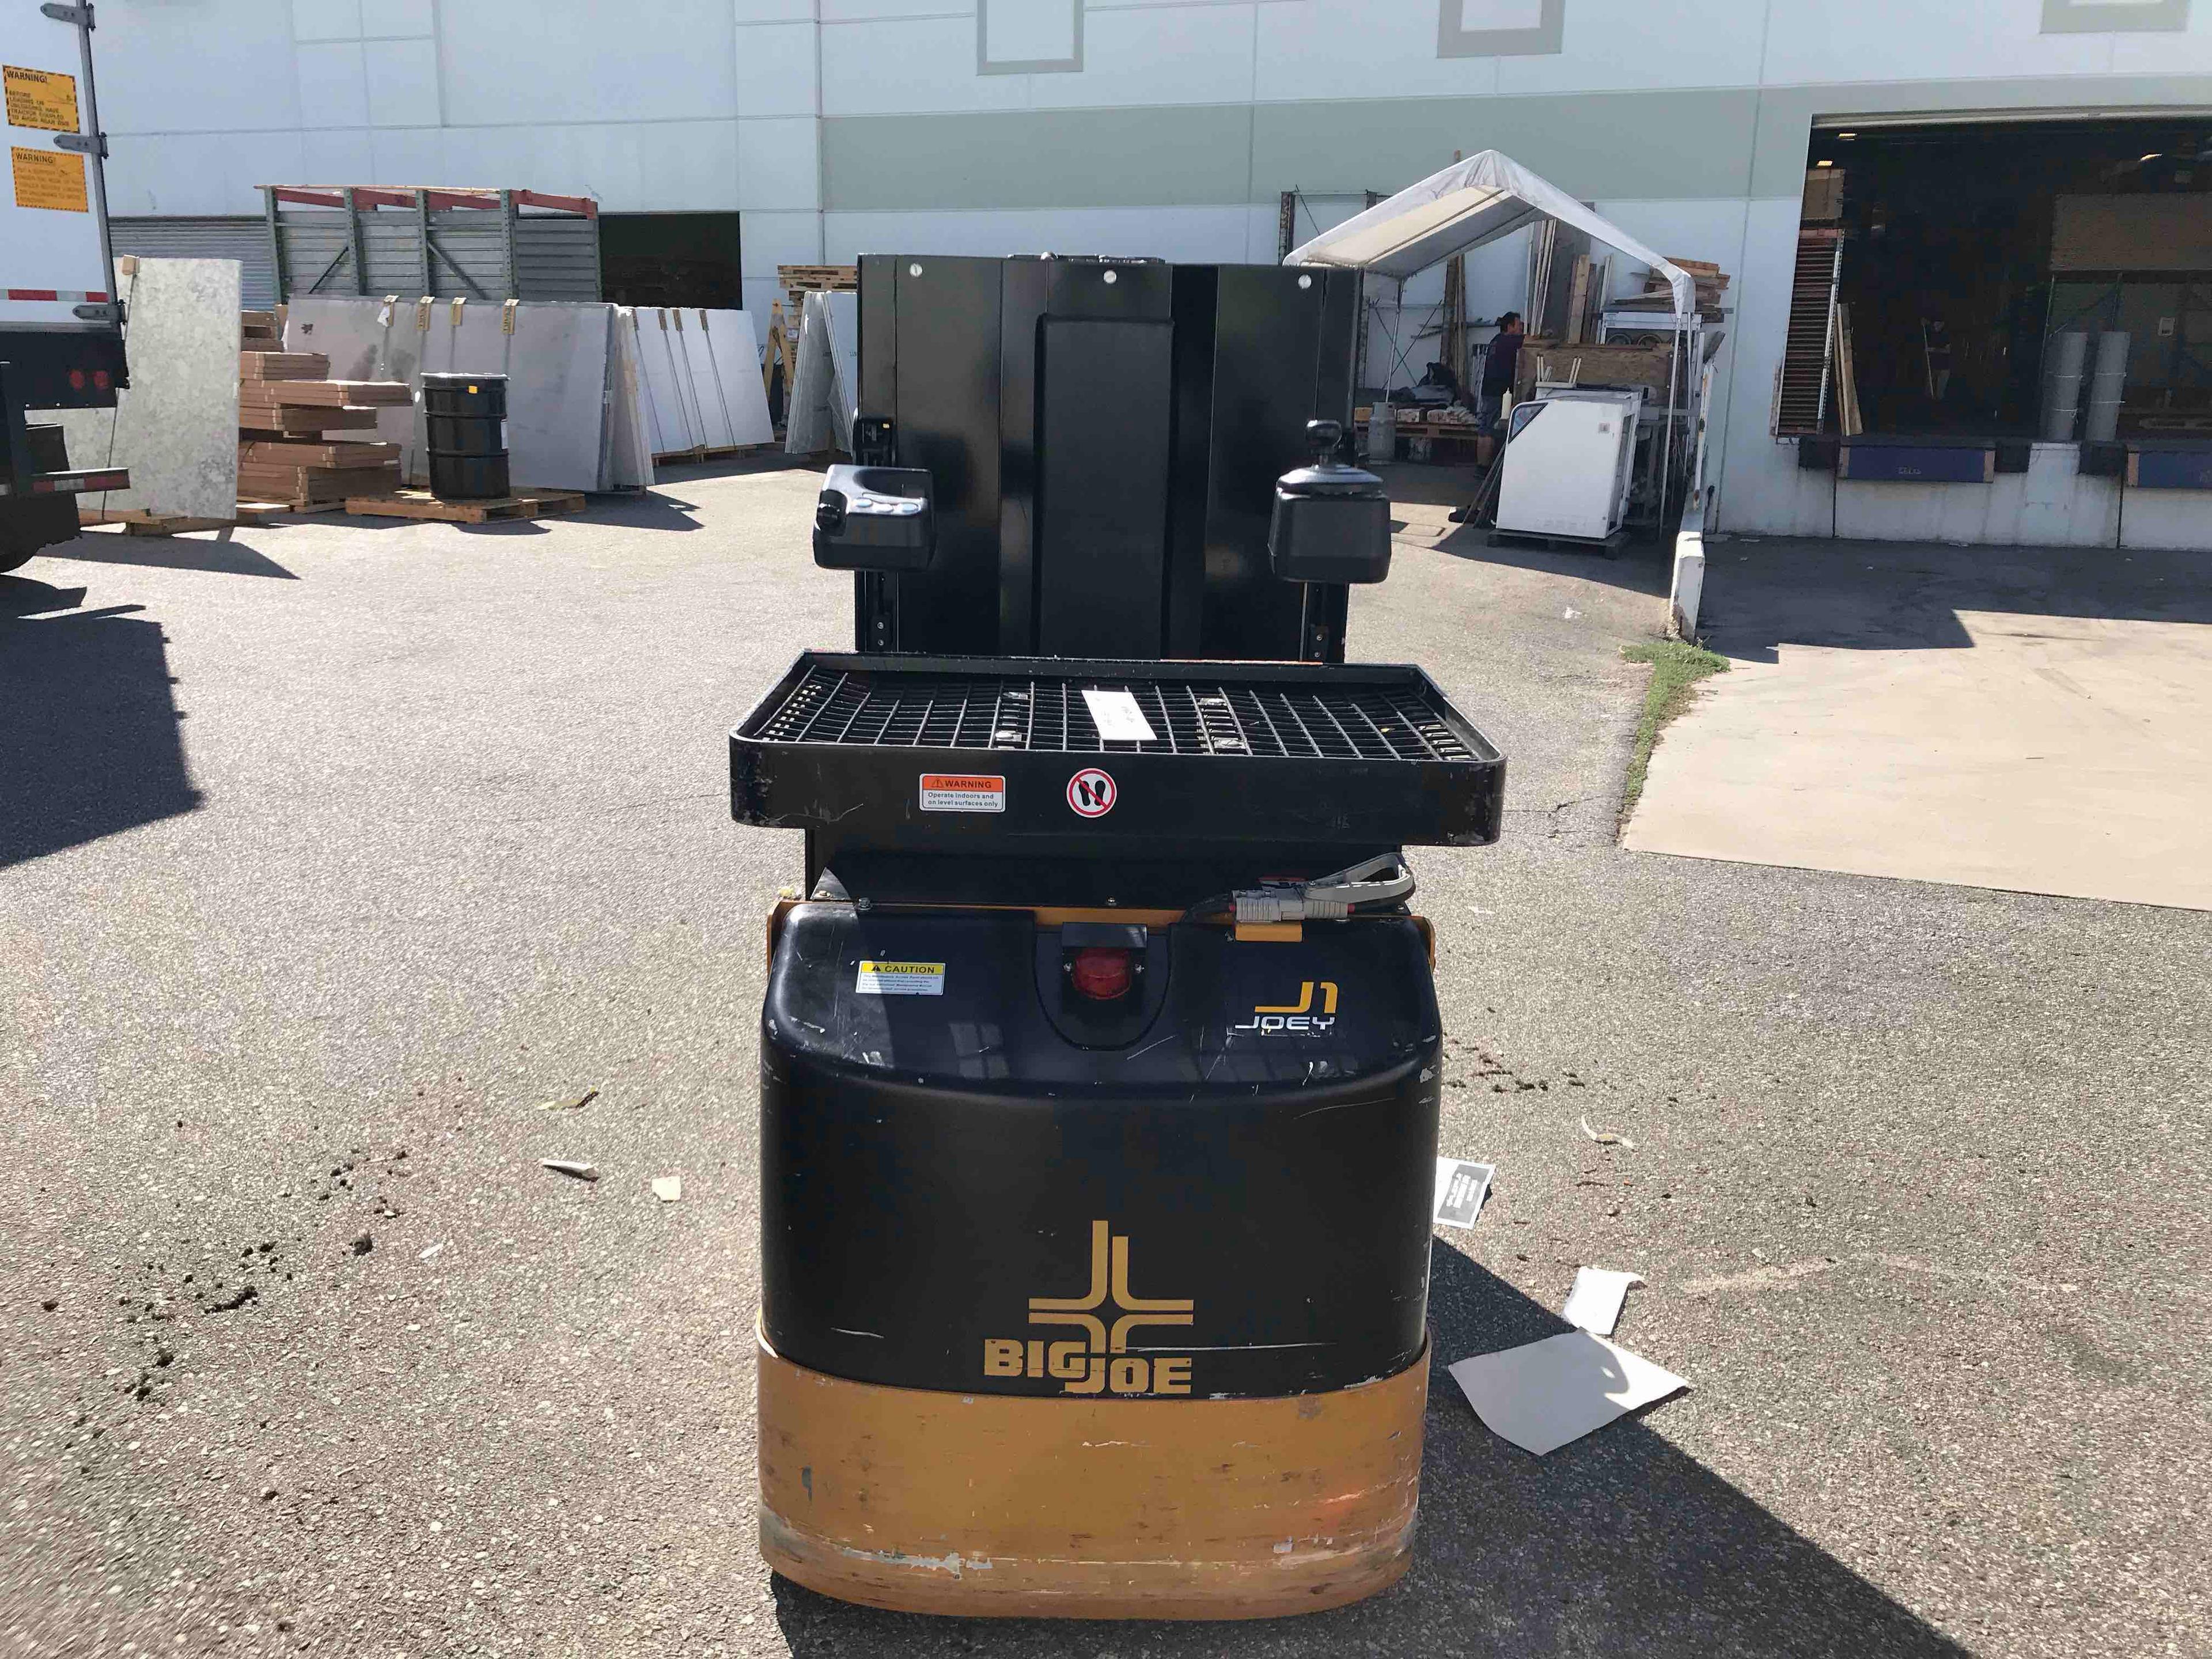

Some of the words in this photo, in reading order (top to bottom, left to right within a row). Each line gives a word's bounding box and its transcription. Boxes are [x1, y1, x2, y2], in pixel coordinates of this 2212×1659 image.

[7, 70, 47, 83] WARNING!
[945, 780, 991, 789] WARNING
[884, 965, 935, 974] CAUTION
[1234, 1016, 1335, 1030] JOEY
